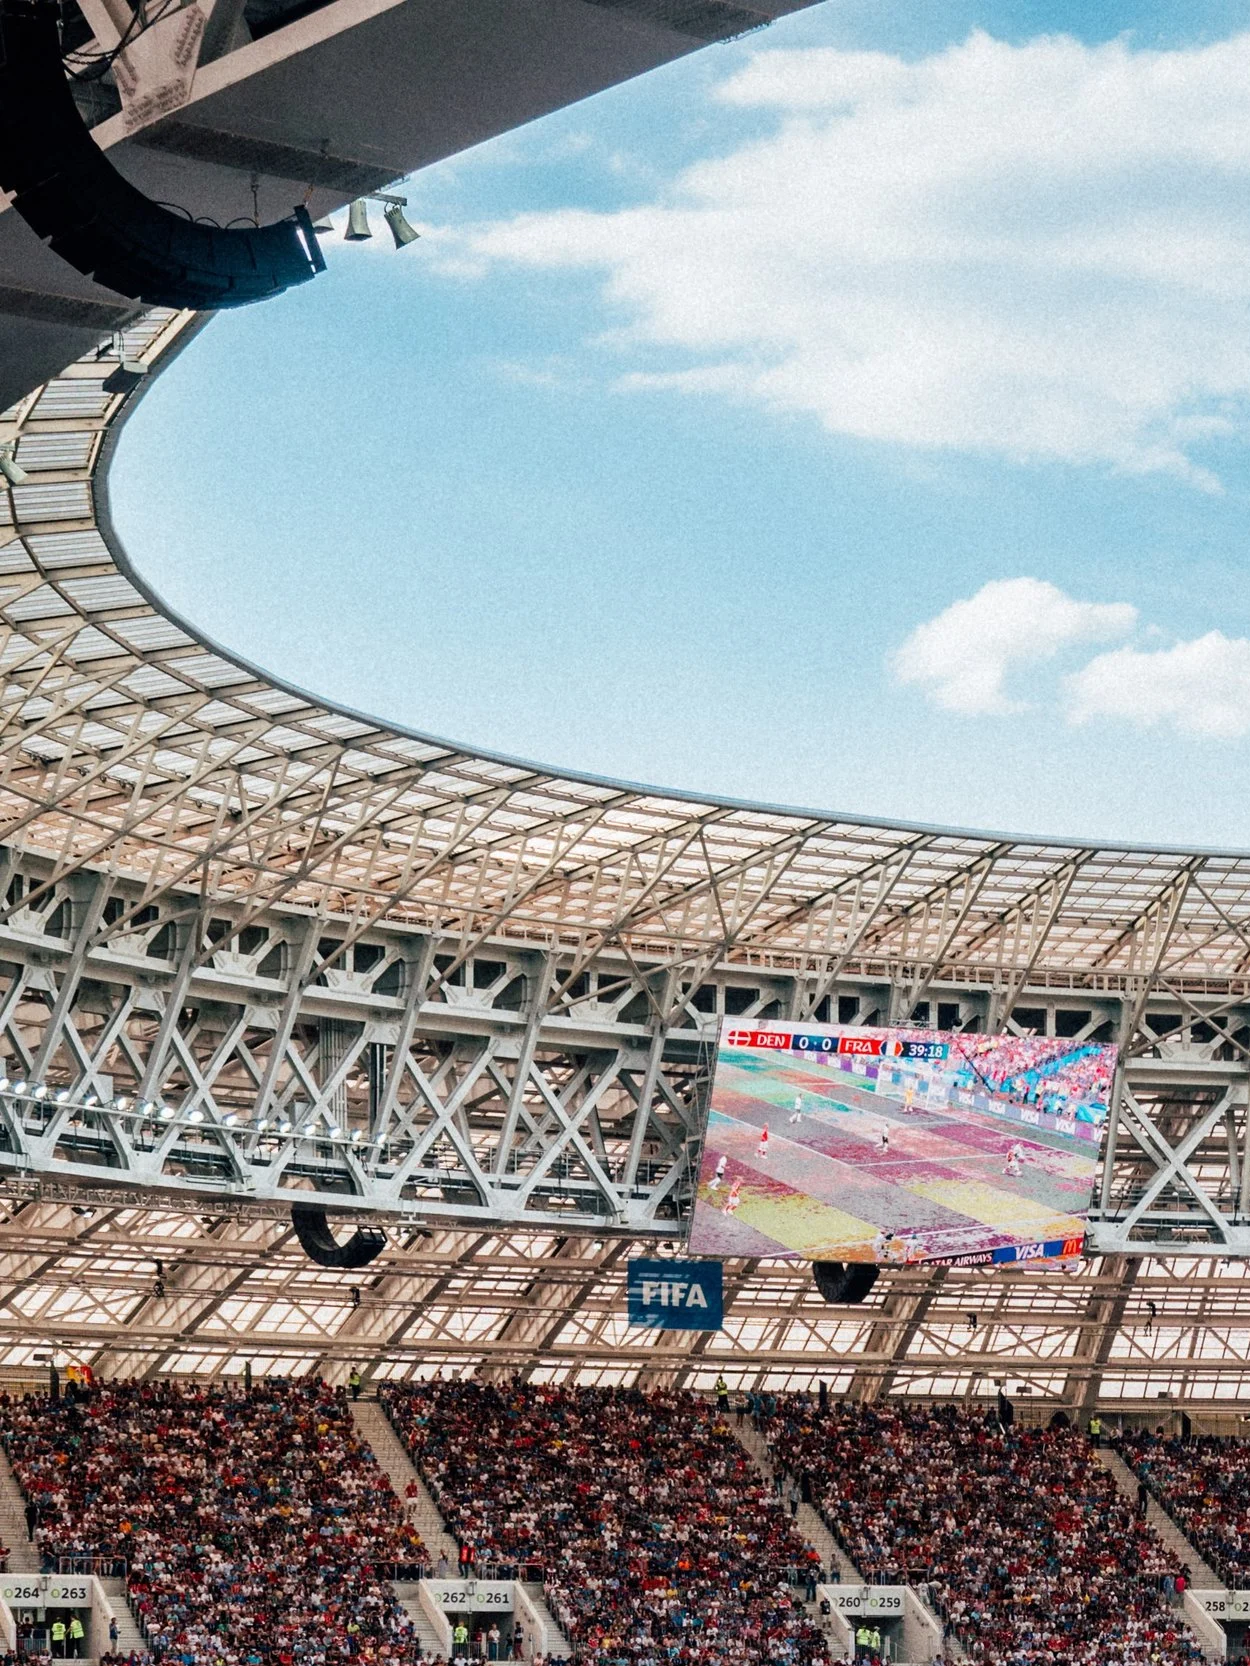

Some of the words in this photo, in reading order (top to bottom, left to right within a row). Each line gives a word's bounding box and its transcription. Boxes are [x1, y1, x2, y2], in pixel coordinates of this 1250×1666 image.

[757, 1034, 785, 1047] DEN
[799, 1036, 808, 1049] 0
[821, 1038, 832, 1050] 0
[845, 1040, 873, 1053] FRA
[909, 1045, 943, 1058] 39:18
[1014, 1243, 1045, 1260] VISA
[952, 1252, 992, 1266] AIRWAYS
[642, 1281, 708, 1308] FIFA
[14, 1587, 39, 1600] 264
[61, 1587, 87, 1600] 263
[443, 1592, 466, 1603] 262
[486, 1592, 510, 1604] 261
[838, 1597, 861, 1607] 260
[879, 1597, 901, 1608] 259
[1205, 1601, 1226, 1612] 258
